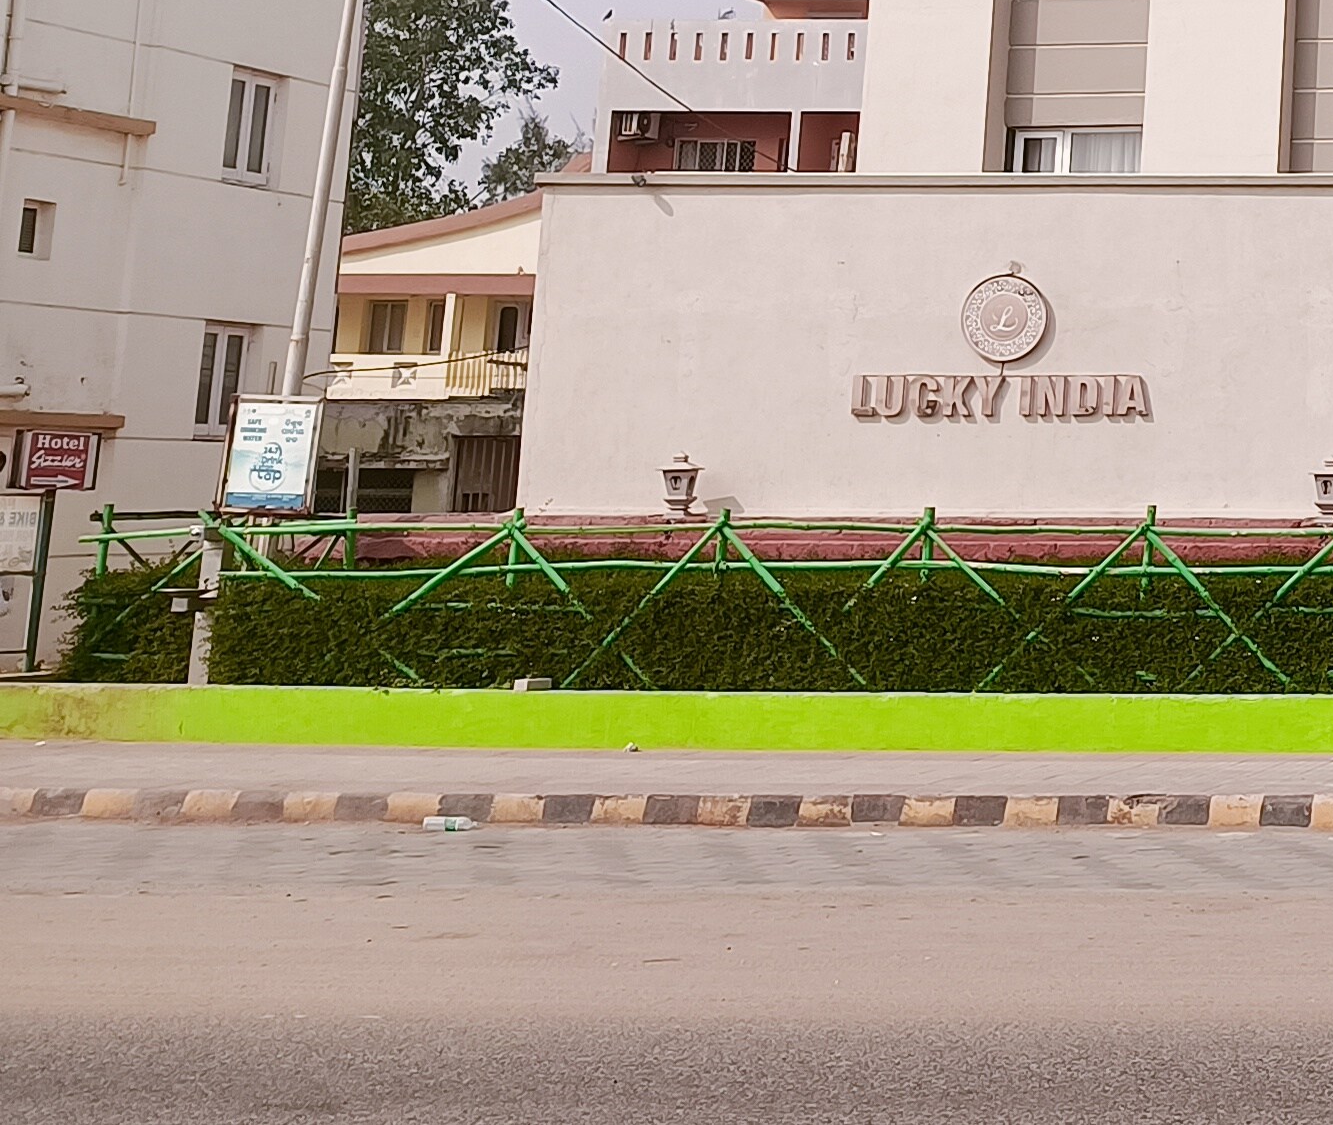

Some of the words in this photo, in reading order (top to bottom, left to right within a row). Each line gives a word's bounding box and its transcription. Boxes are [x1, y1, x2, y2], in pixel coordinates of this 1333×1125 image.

[989, 305, 1019, 332] L
[851, 375, 1004, 418] LUCKY
[1019, 375, 1150, 418] INDIA
[37, 434, 85, 450] Hotel
